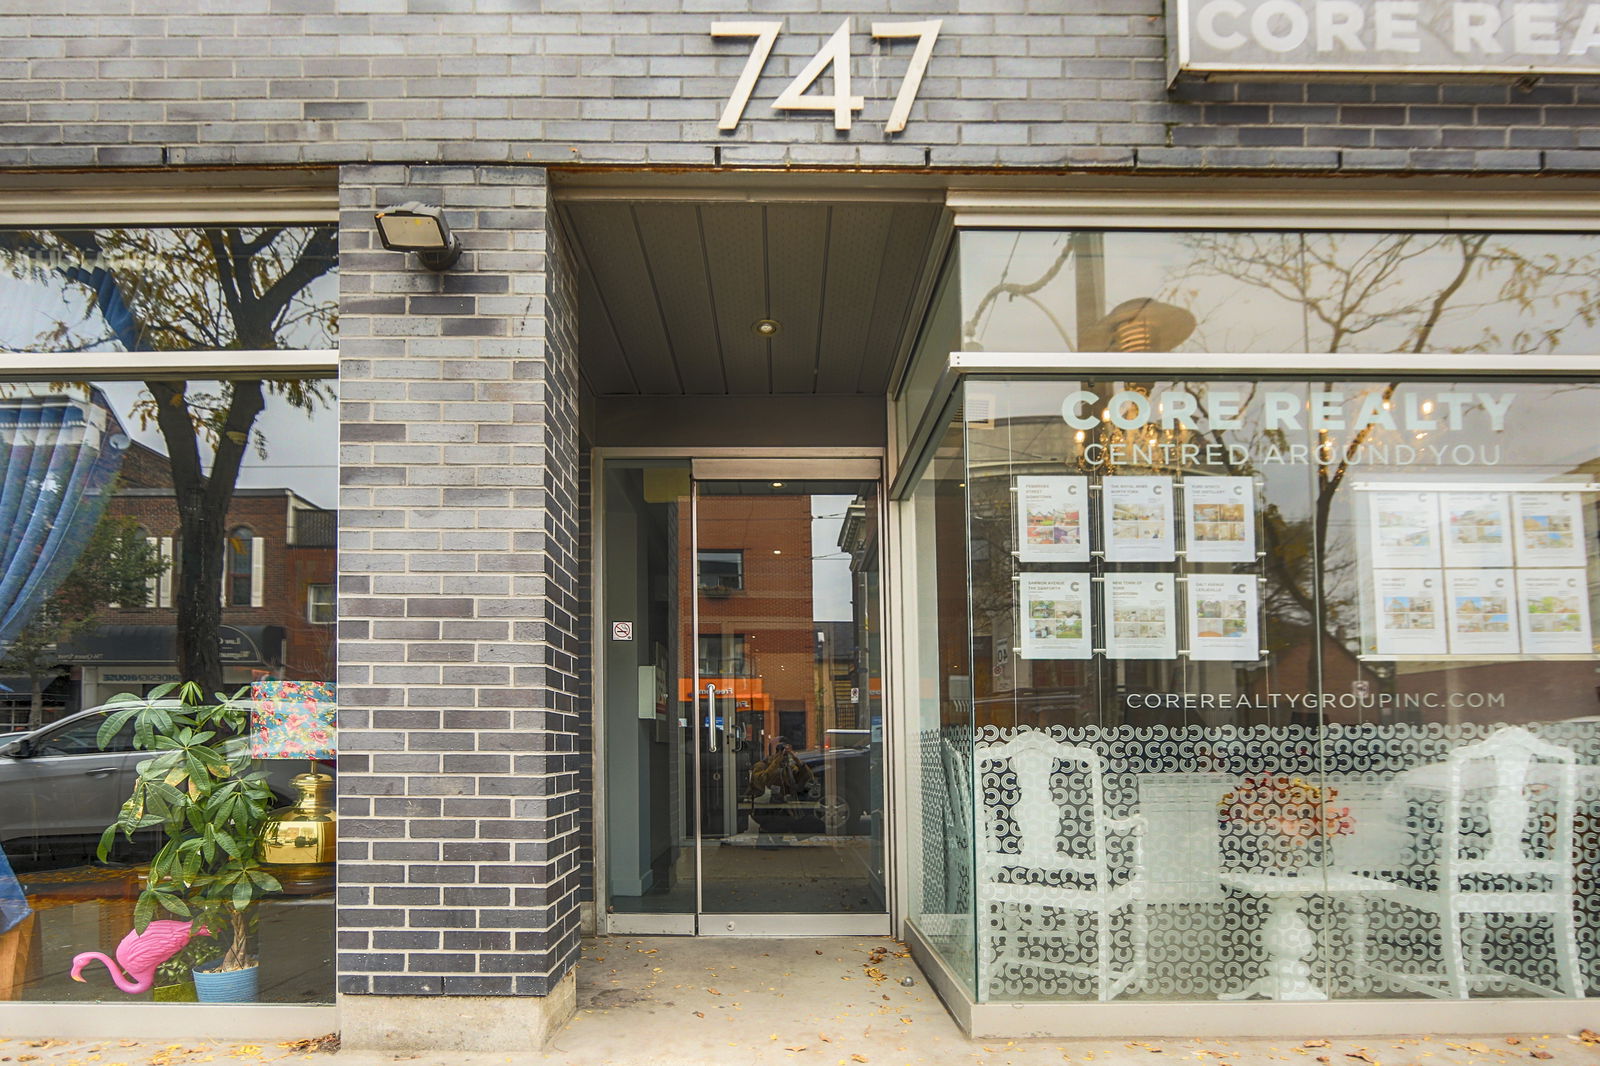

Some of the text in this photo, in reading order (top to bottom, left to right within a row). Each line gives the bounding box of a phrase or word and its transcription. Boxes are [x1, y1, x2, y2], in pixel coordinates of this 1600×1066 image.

[1196, 0, 1421, 52] CORE
[711, 16, 943, 132] 747
[1062, 390, 1517, 431] CORE REALTY
[1084, 443, 1501, 465] CENTRED AROUND YOU
[1126, 692, 1505, 709] COREREALTYGROUPINC.COM
